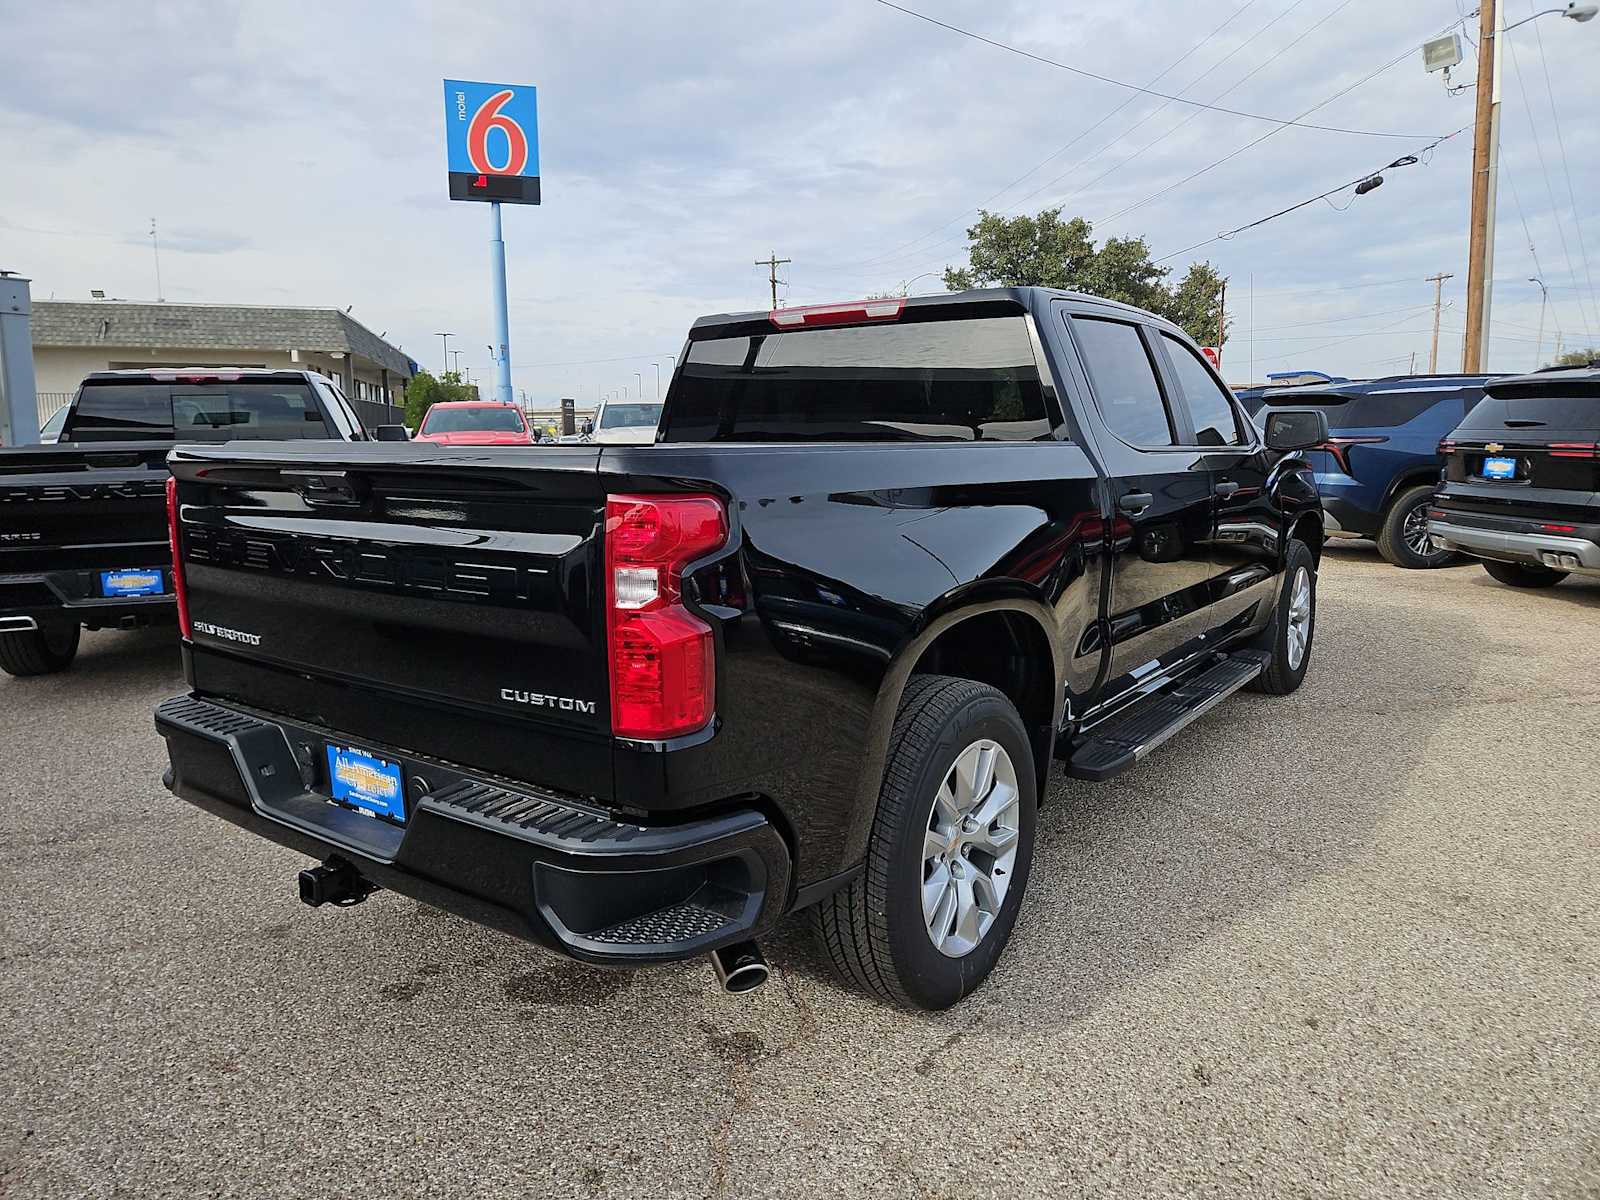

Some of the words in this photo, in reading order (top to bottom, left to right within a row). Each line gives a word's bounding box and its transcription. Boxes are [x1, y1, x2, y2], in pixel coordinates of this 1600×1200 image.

[456, 91, 466, 121] motel
[467, 89, 529, 177] 6
[188, 529, 550, 600] CHEVROLET
[194, 621, 262, 646] SILVERADO
[500, 688, 596, 714] CUSTOM
[335, 756, 349, 771] All
